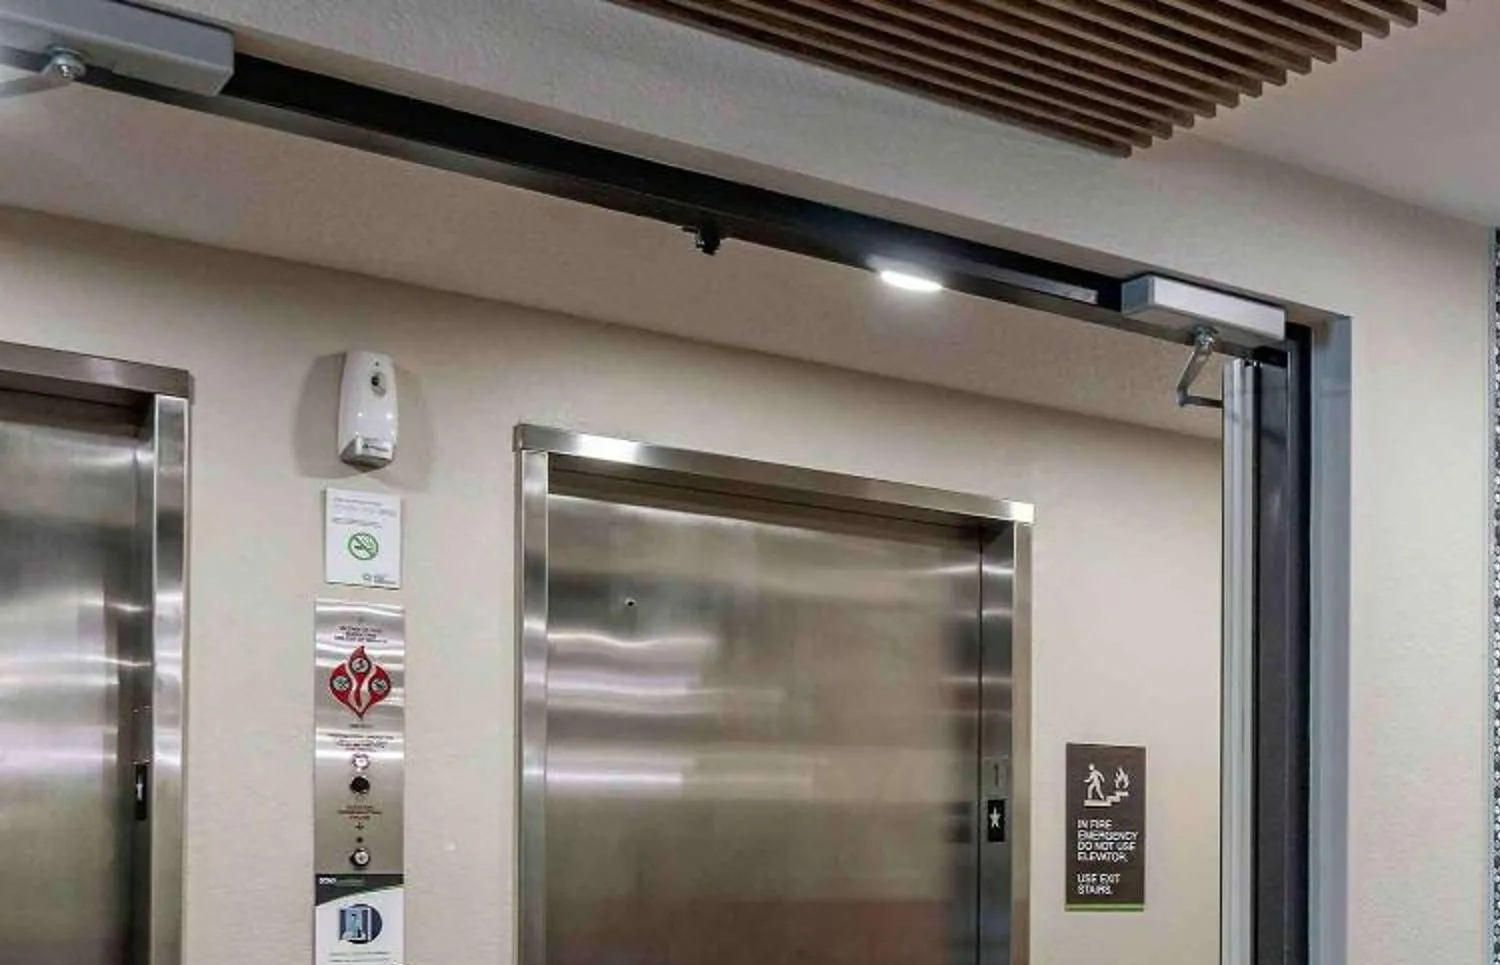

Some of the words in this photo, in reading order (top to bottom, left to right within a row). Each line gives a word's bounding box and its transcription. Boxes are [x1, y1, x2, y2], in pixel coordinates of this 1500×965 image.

[1077, 819, 1088, 829] IN
[1077, 830, 1139, 841] EMERGENCY
[1077, 841, 1093, 851] DO
[1094, 842, 1114, 851] NOT
[1099, 873, 1121, 885] EXIT
